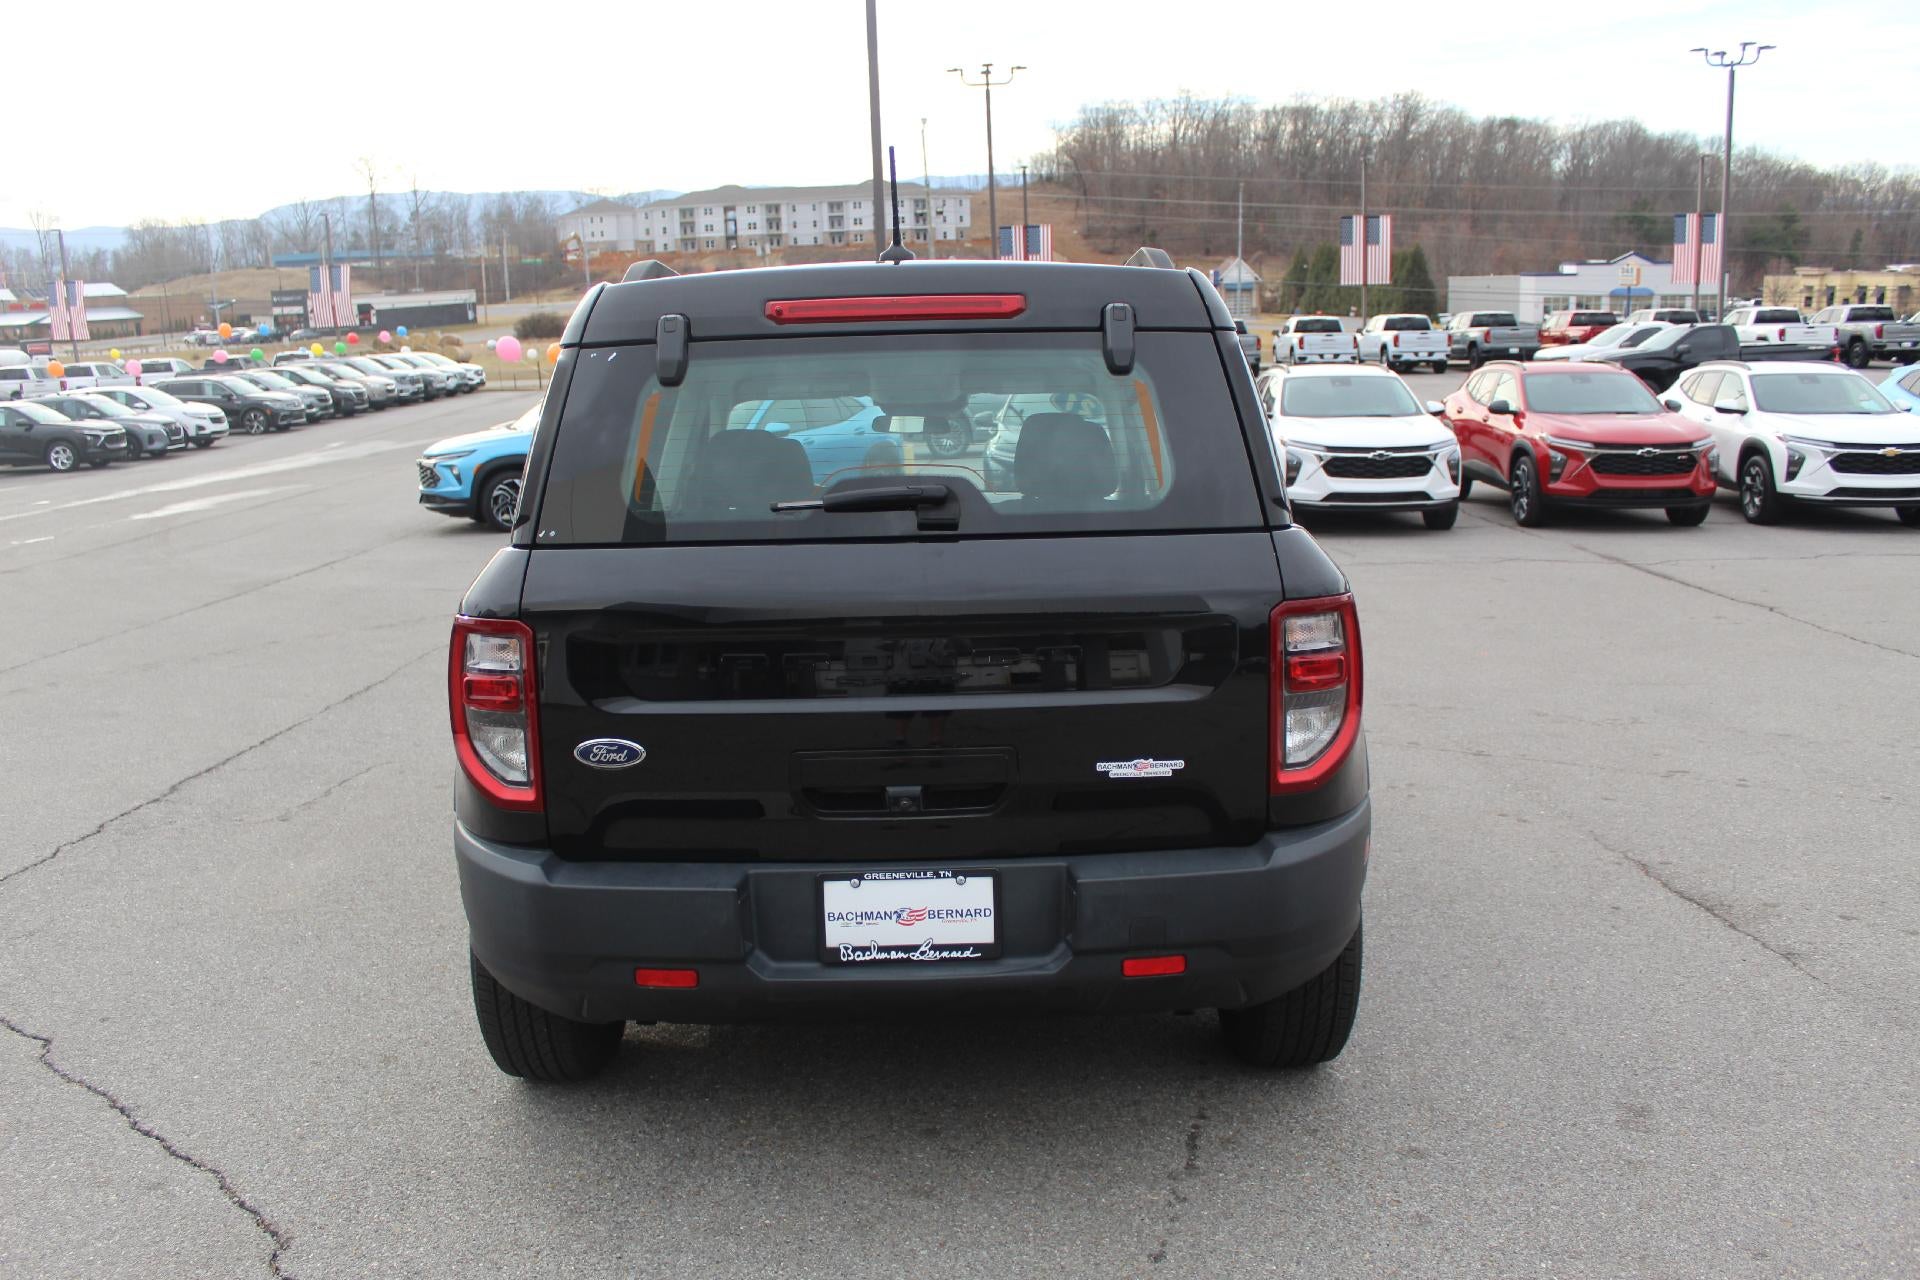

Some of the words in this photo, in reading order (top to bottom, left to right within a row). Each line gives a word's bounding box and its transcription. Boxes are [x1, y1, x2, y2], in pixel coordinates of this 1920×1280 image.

[589, 745, 628, 762] Ford
[863, 871, 936, 880] GREENEVILLE,
[827, 911, 893, 922] BACHMAN
[928, 908, 992, 920] BERNARD
[839, 940, 910, 962] Bachman
[910, 938, 981, 960] Bernard
